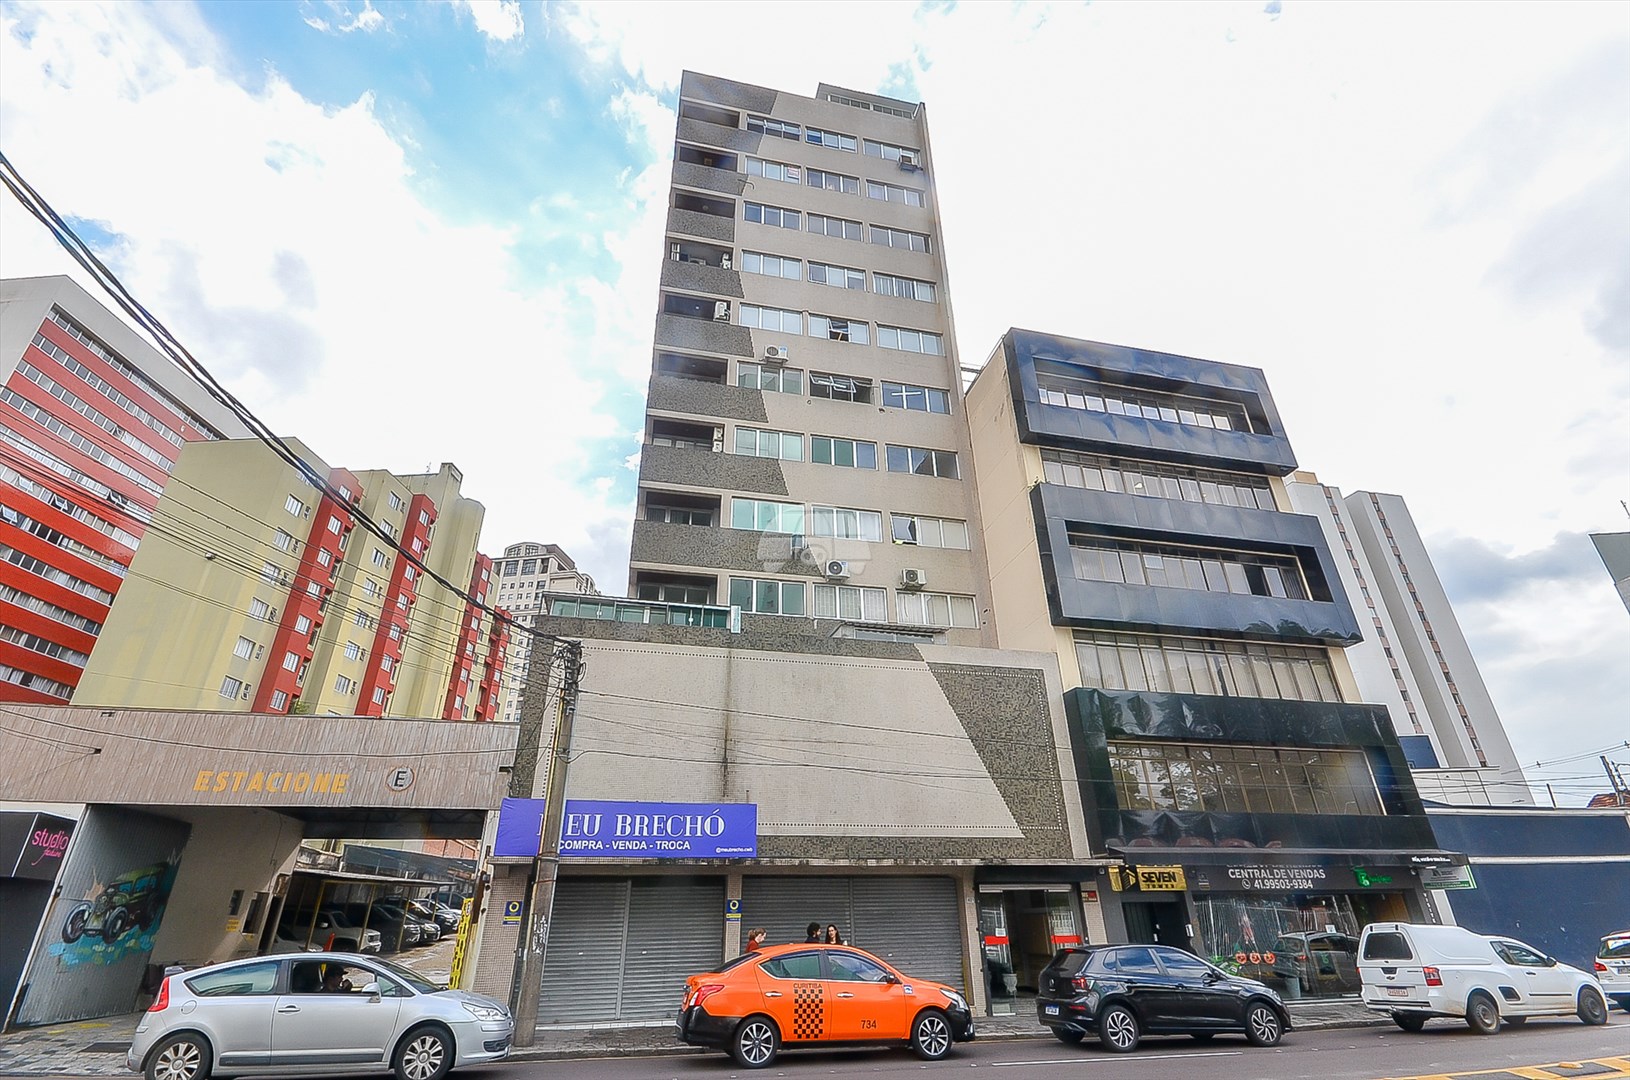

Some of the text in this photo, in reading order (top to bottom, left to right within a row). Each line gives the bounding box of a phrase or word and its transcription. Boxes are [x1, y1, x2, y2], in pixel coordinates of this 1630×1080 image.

[193, 770, 349, 793] ESTACIONE
[393, 770, 408, 788] E
[615, 808, 725, 837] BRECHÓ
[32, 828, 69, 850] studio
[559, 840, 603, 850] COMPRA
[612, 840, 648, 850] VENDA
[655, 840, 691, 850] TROCA
[1141, 871, 1177, 883] SEVEN
[1228, 868, 1326, 879] CENTRAL DE VENDAS
[1253, 879, 1314, 889] 41.99503-9384
[860, 1019, 877, 1029] 734
